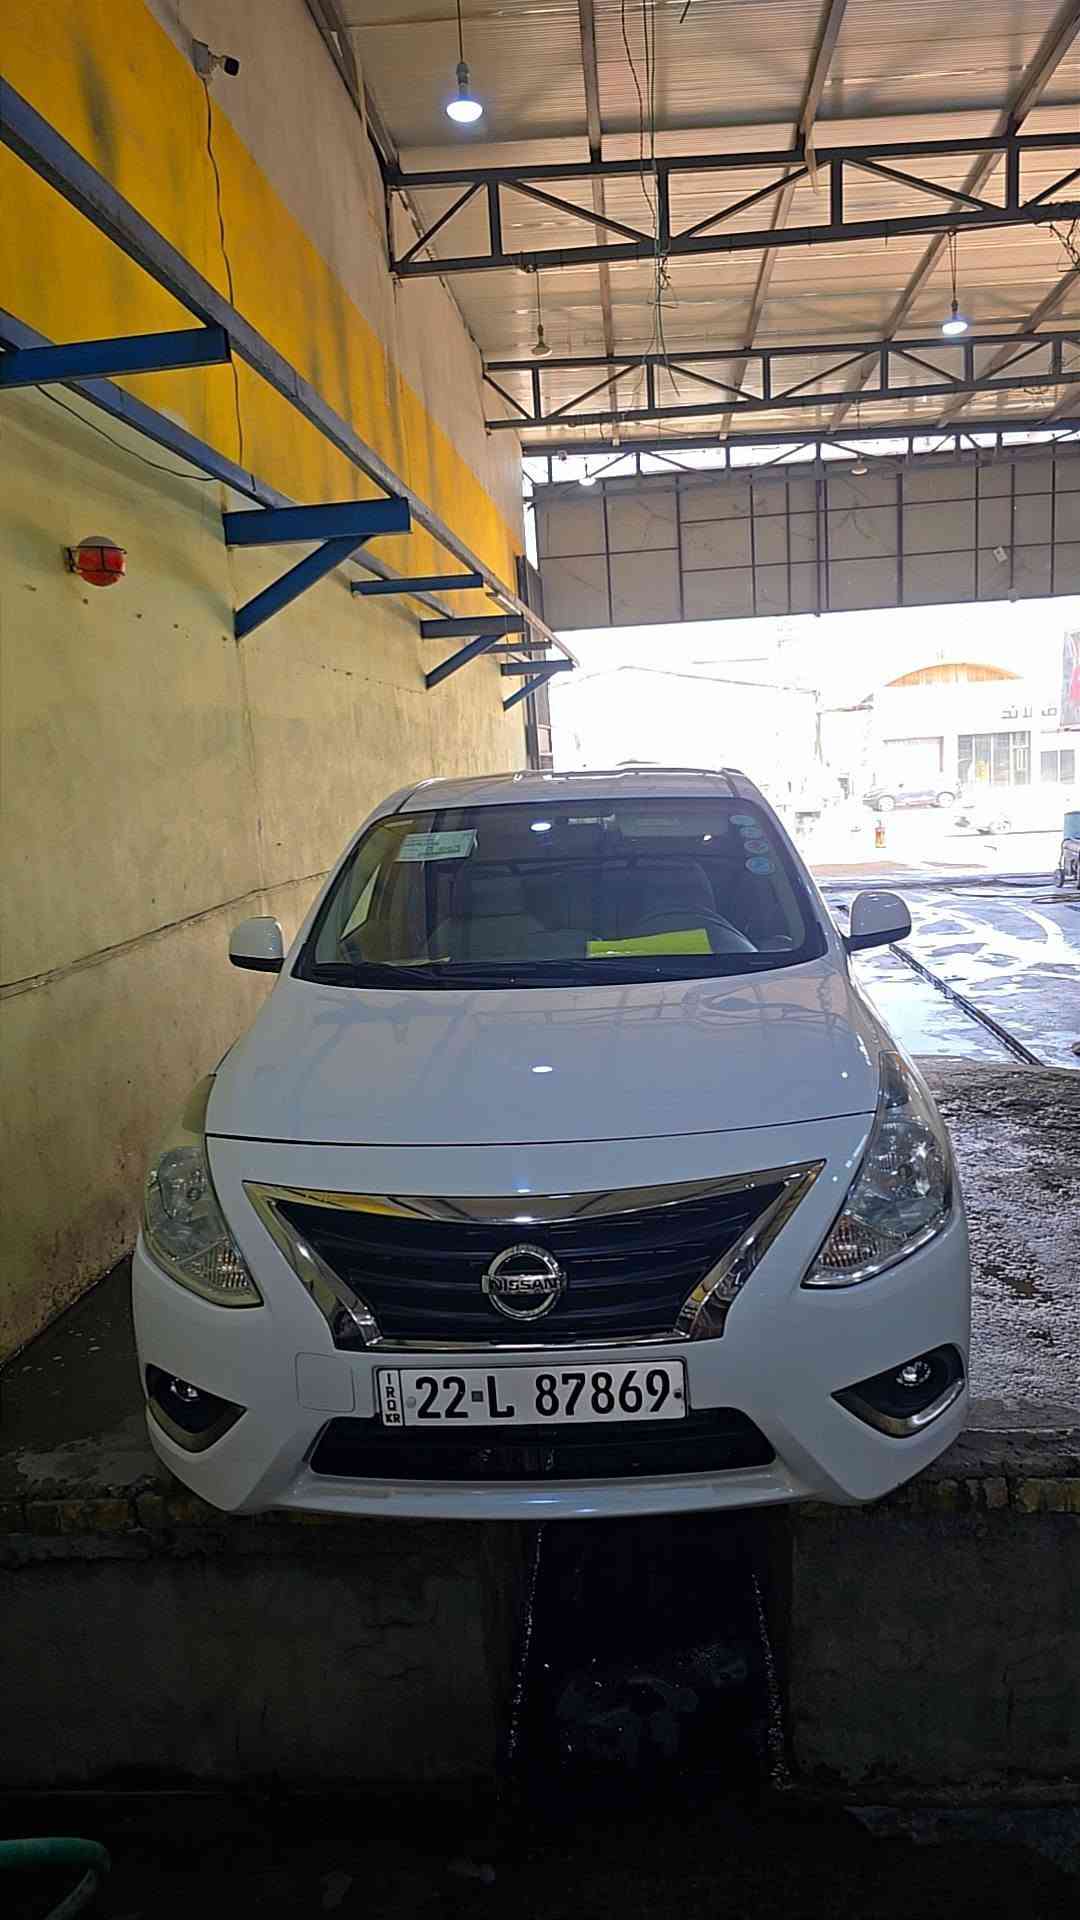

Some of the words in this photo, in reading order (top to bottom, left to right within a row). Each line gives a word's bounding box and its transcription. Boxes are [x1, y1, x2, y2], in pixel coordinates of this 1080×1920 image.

[493, 1279, 558, 1291] NISSAN
[535, 1369, 670, 1416] 87869
[385, 1413, 400, 1423] KR
